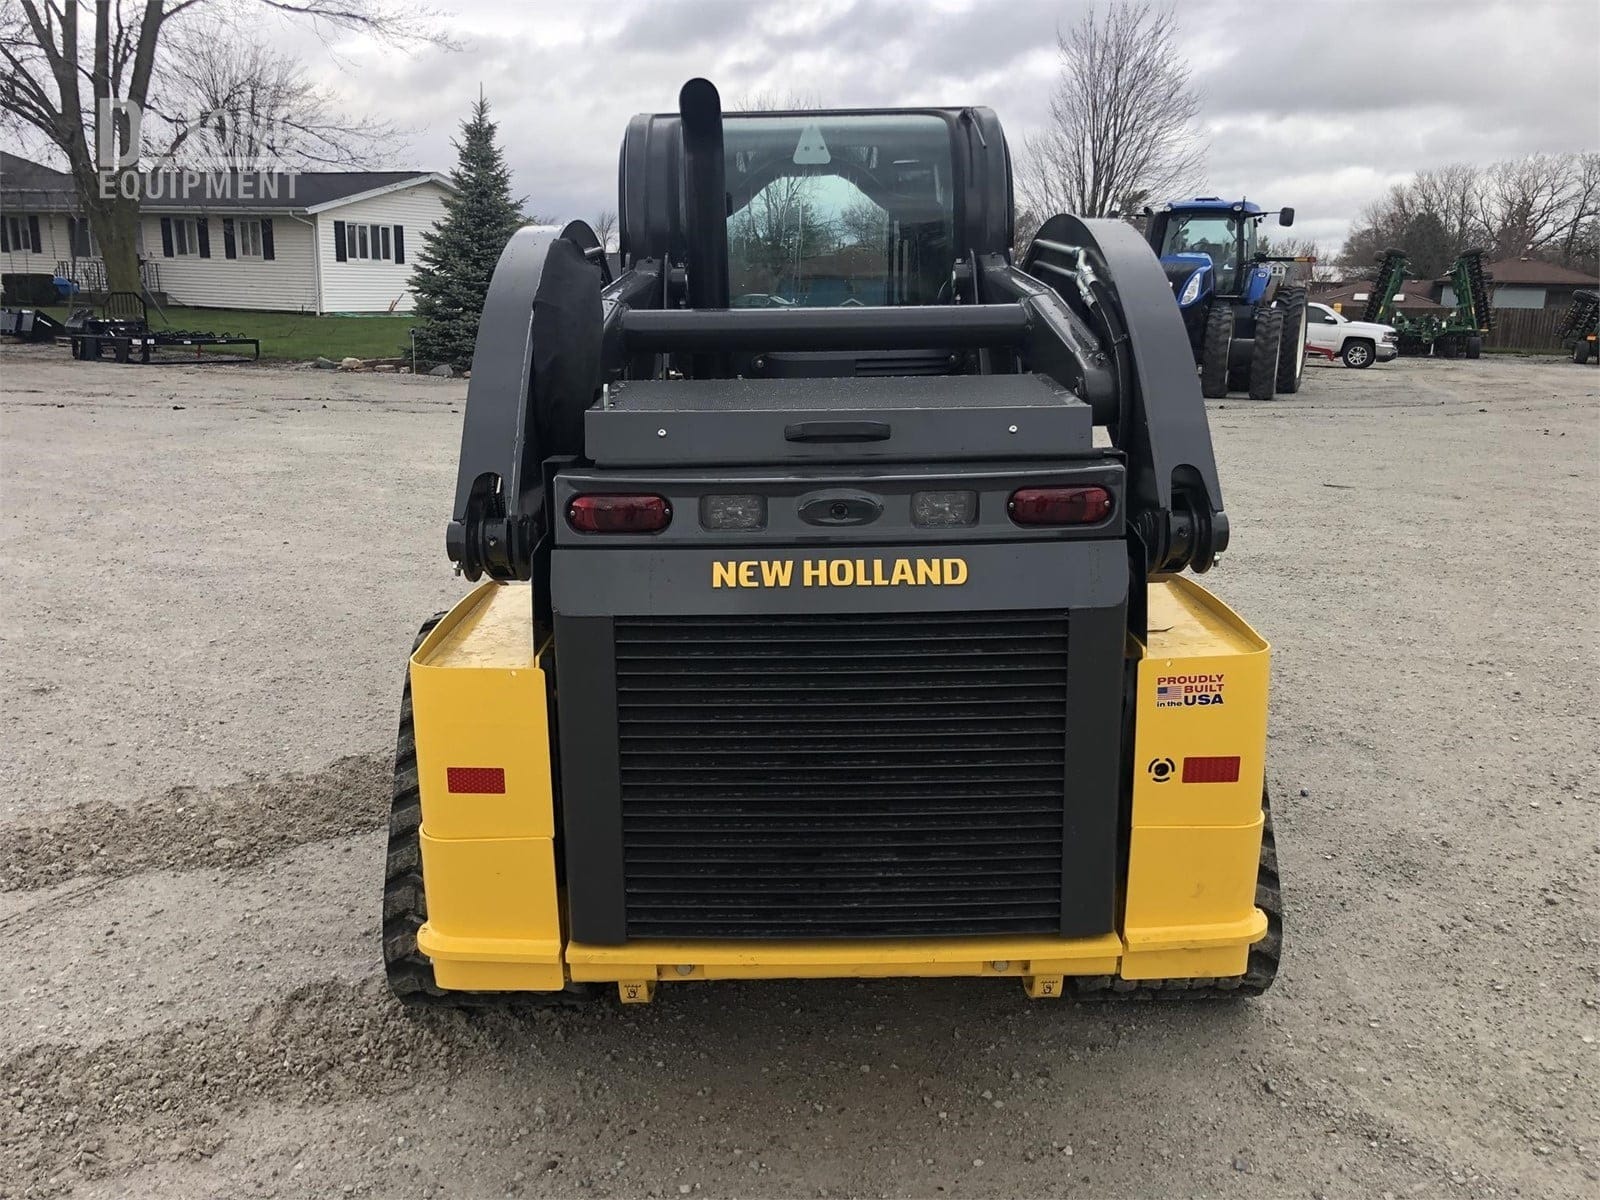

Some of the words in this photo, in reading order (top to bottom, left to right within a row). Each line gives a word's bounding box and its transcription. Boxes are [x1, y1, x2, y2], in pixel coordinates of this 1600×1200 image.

[712, 560, 794, 588] NEW
[803, 558, 968, 587] HOLLAND
[1157, 674, 1224, 685] PROUDLY
[1184, 684, 1224, 693] BUILT
[1184, 694, 1224, 706] USA
